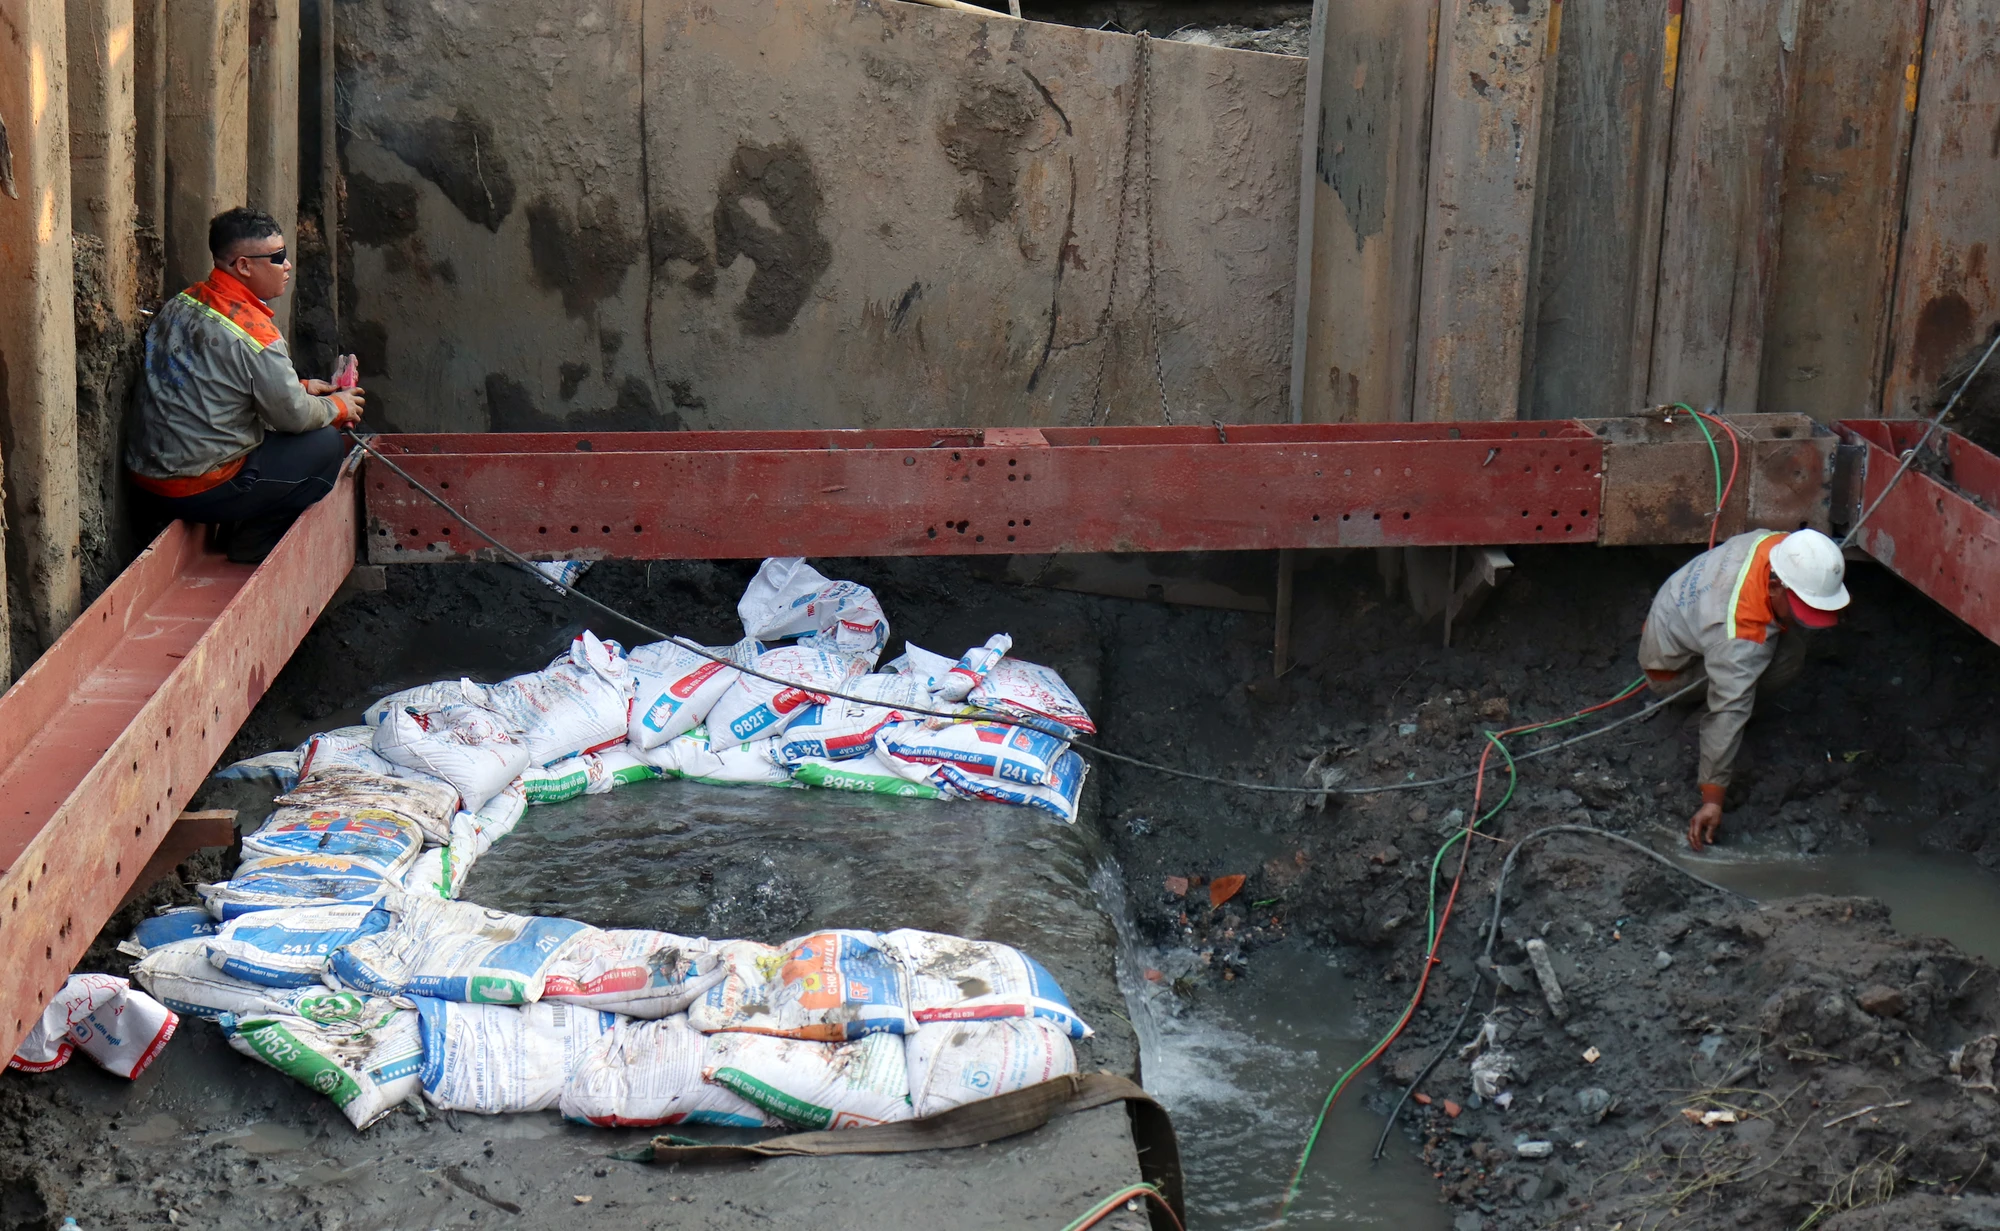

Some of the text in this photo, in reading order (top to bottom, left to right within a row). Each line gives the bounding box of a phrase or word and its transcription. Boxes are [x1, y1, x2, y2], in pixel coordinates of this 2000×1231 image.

[938, 749, 954, 759] HỢP
[954, 752, 968, 762] CAO
[968, 754, 983, 764] CẤP
[1003, 763, 1027, 782] 241
[1032, 774, 1042, 786] S
[191, 922, 213, 935] 24
[281, 942, 328, 955] 241 S
[536, 935, 560, 954] 276
[426, 976, 441, 986] HEO
[162, 1024, 176, 1042] CHO
[741, 1079, 755, 1096] CHO
[755, 1087, 765, 1101] GÀ
